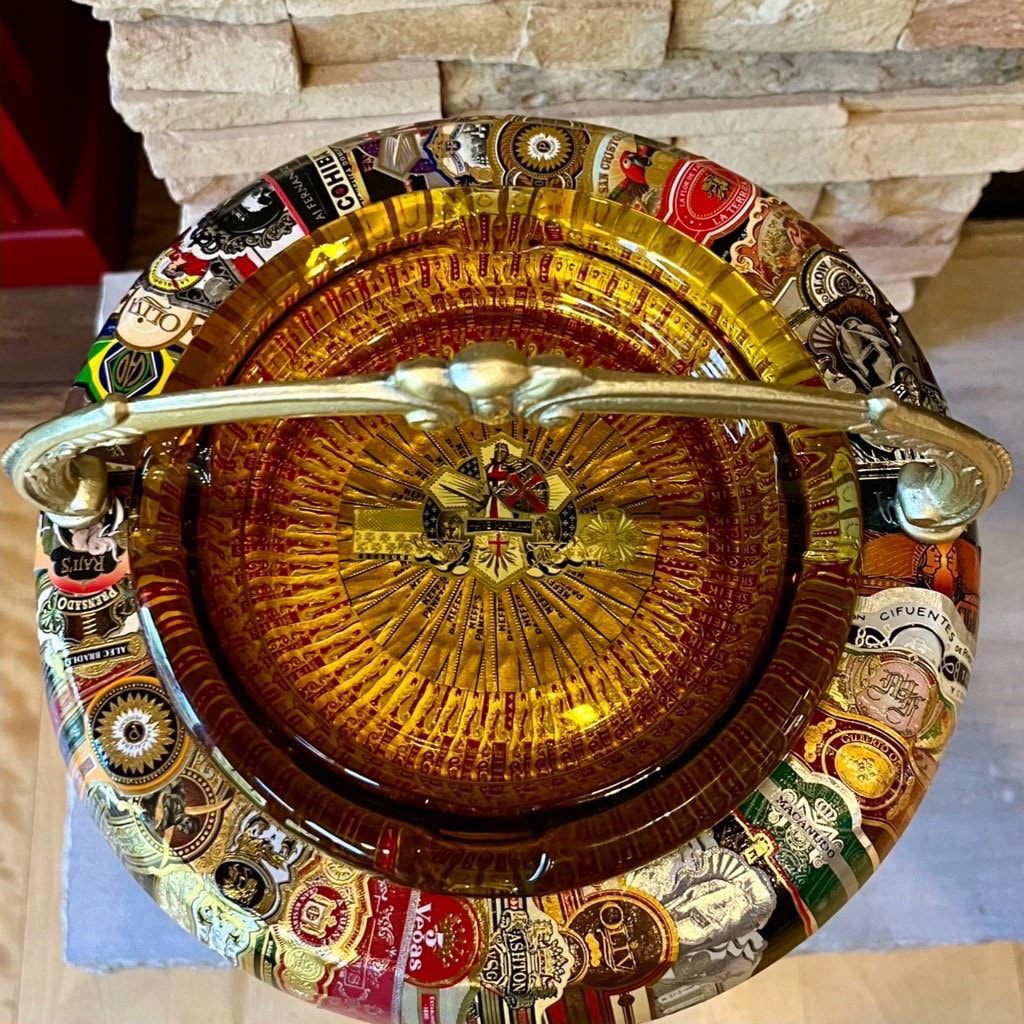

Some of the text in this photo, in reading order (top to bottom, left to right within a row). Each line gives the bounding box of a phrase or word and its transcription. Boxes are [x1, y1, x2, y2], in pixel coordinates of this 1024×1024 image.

[712, 214, 728, 225] LA
[57, 586, 118, 611] PRENSADO
[880, 606, 955, 642] CIFUENTES
[841, 734, 889, 752] GILBERTO
[777, 796, 835, 858] MACANUDO
[409, 902, 444, 971] 5 Vegas
[507, 931, 527, 992] ASHTON
